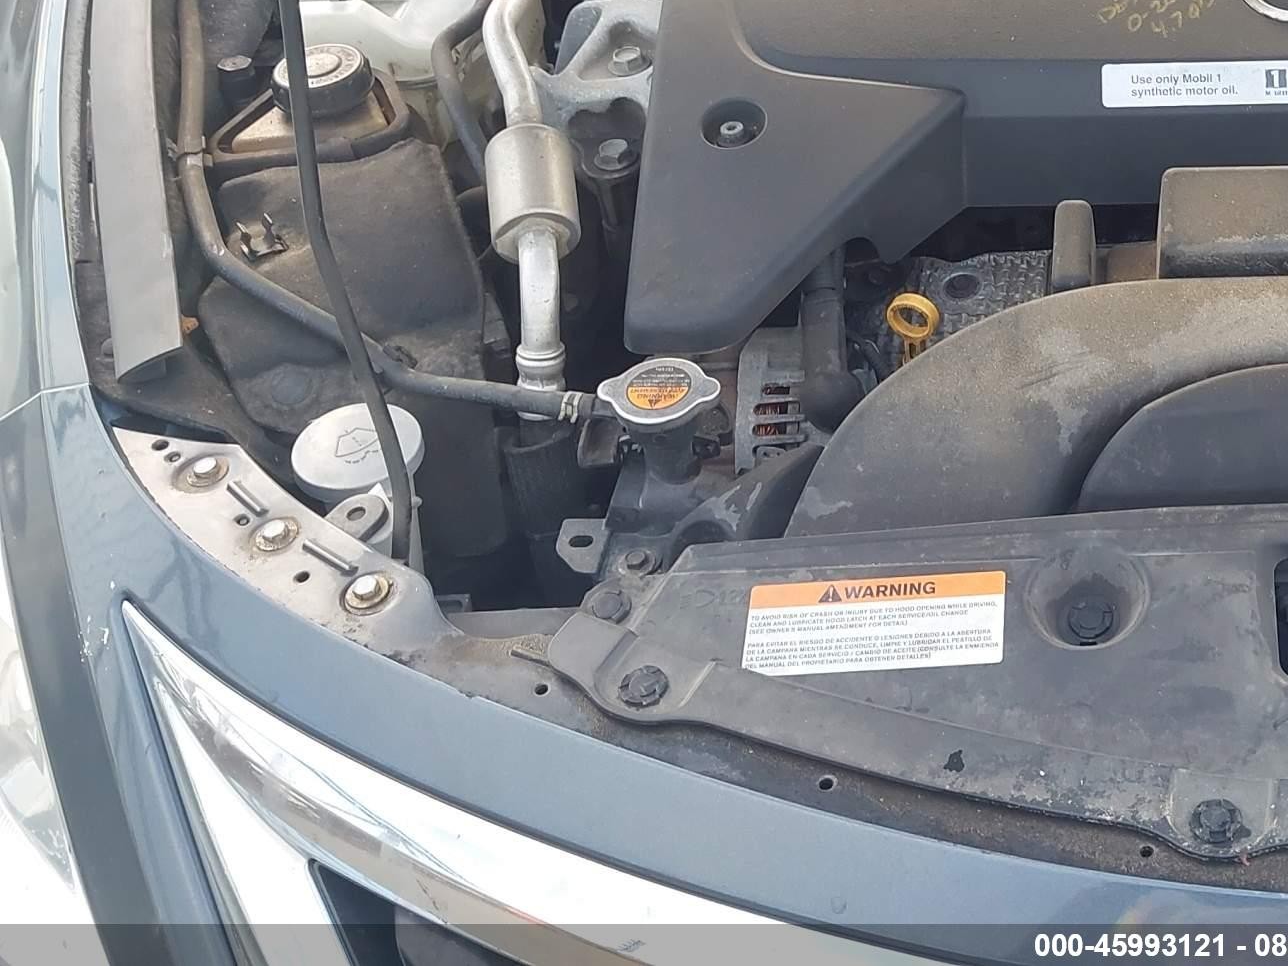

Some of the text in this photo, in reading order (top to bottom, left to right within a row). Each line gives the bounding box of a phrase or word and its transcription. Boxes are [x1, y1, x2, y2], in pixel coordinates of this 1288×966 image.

[1131, 72, 1222, 87] Use only Mobil 1
[1131, 84, 1239, 98] synthetic motor oil.
[845, 581, 936, 599] WARNING
